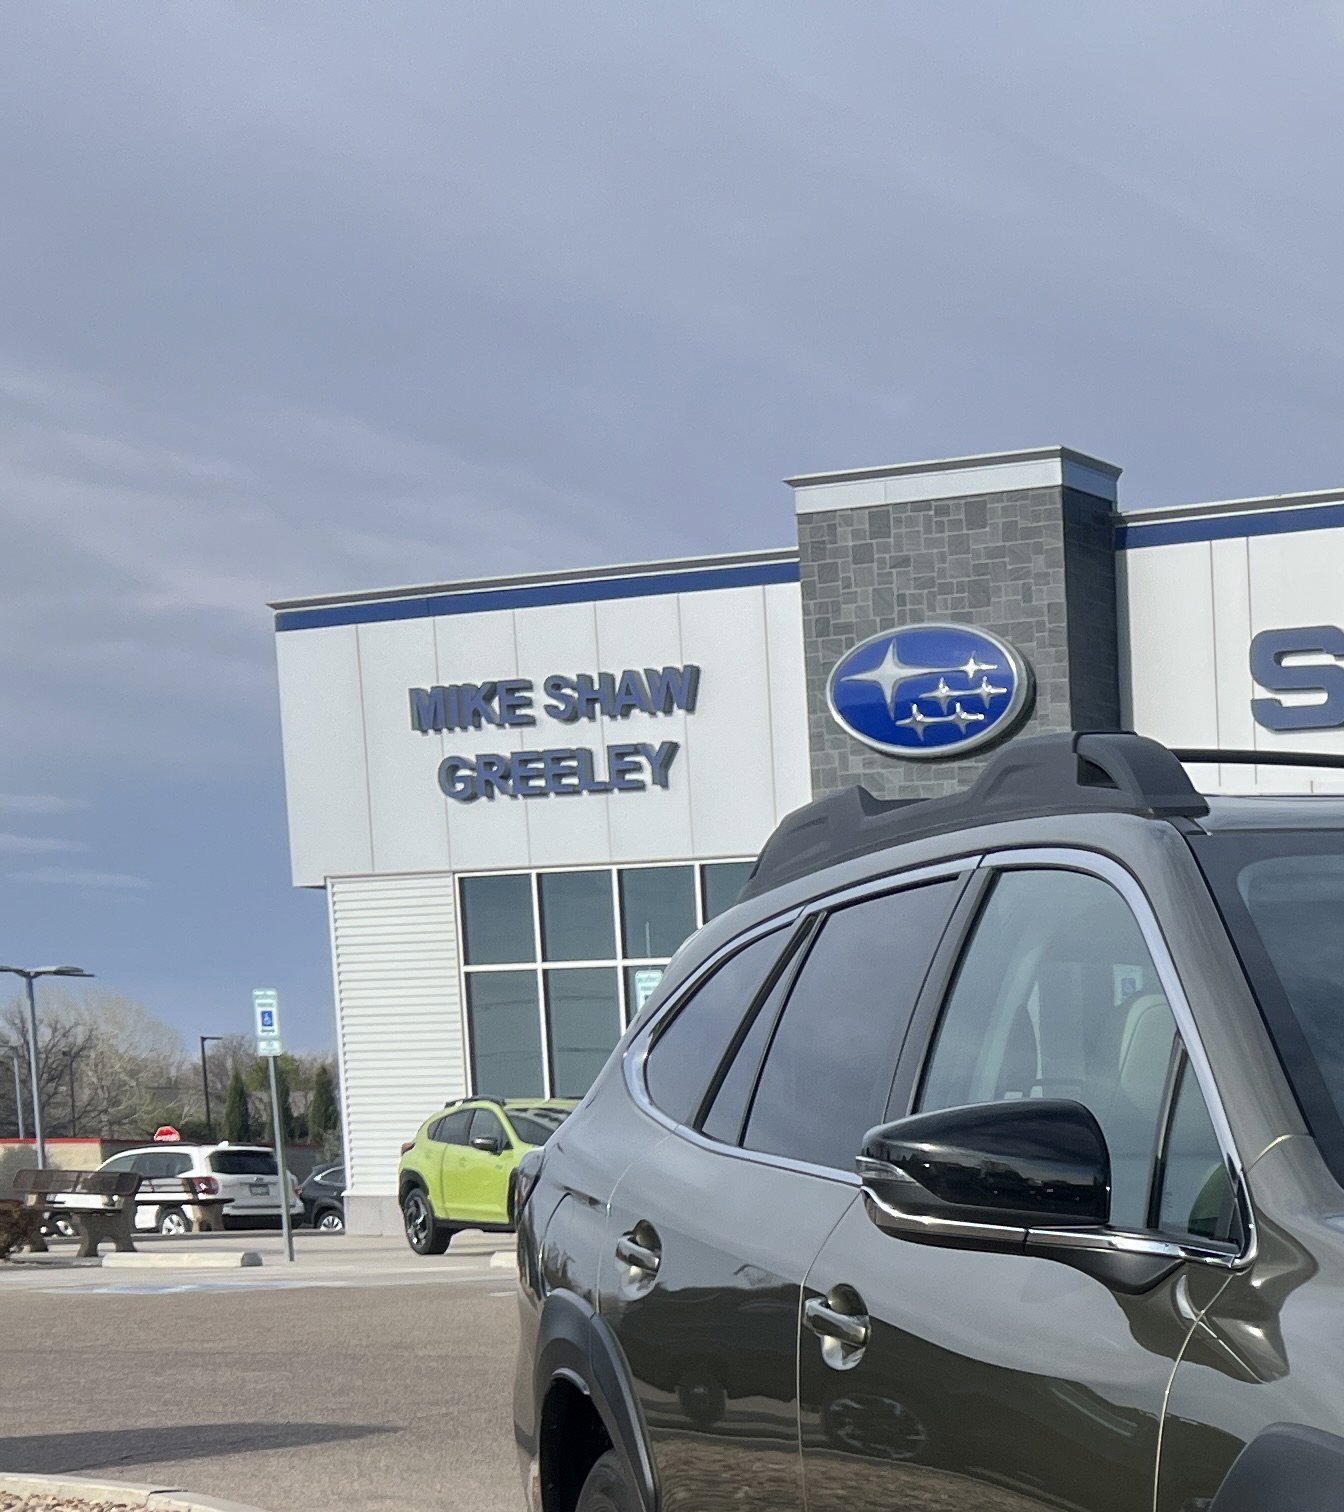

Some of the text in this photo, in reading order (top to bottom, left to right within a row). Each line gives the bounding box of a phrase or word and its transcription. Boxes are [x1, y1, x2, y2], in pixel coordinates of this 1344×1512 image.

[408, 664, 701, 735] MIKE SHAW
[437, 740, 680, 804] GREELEY
